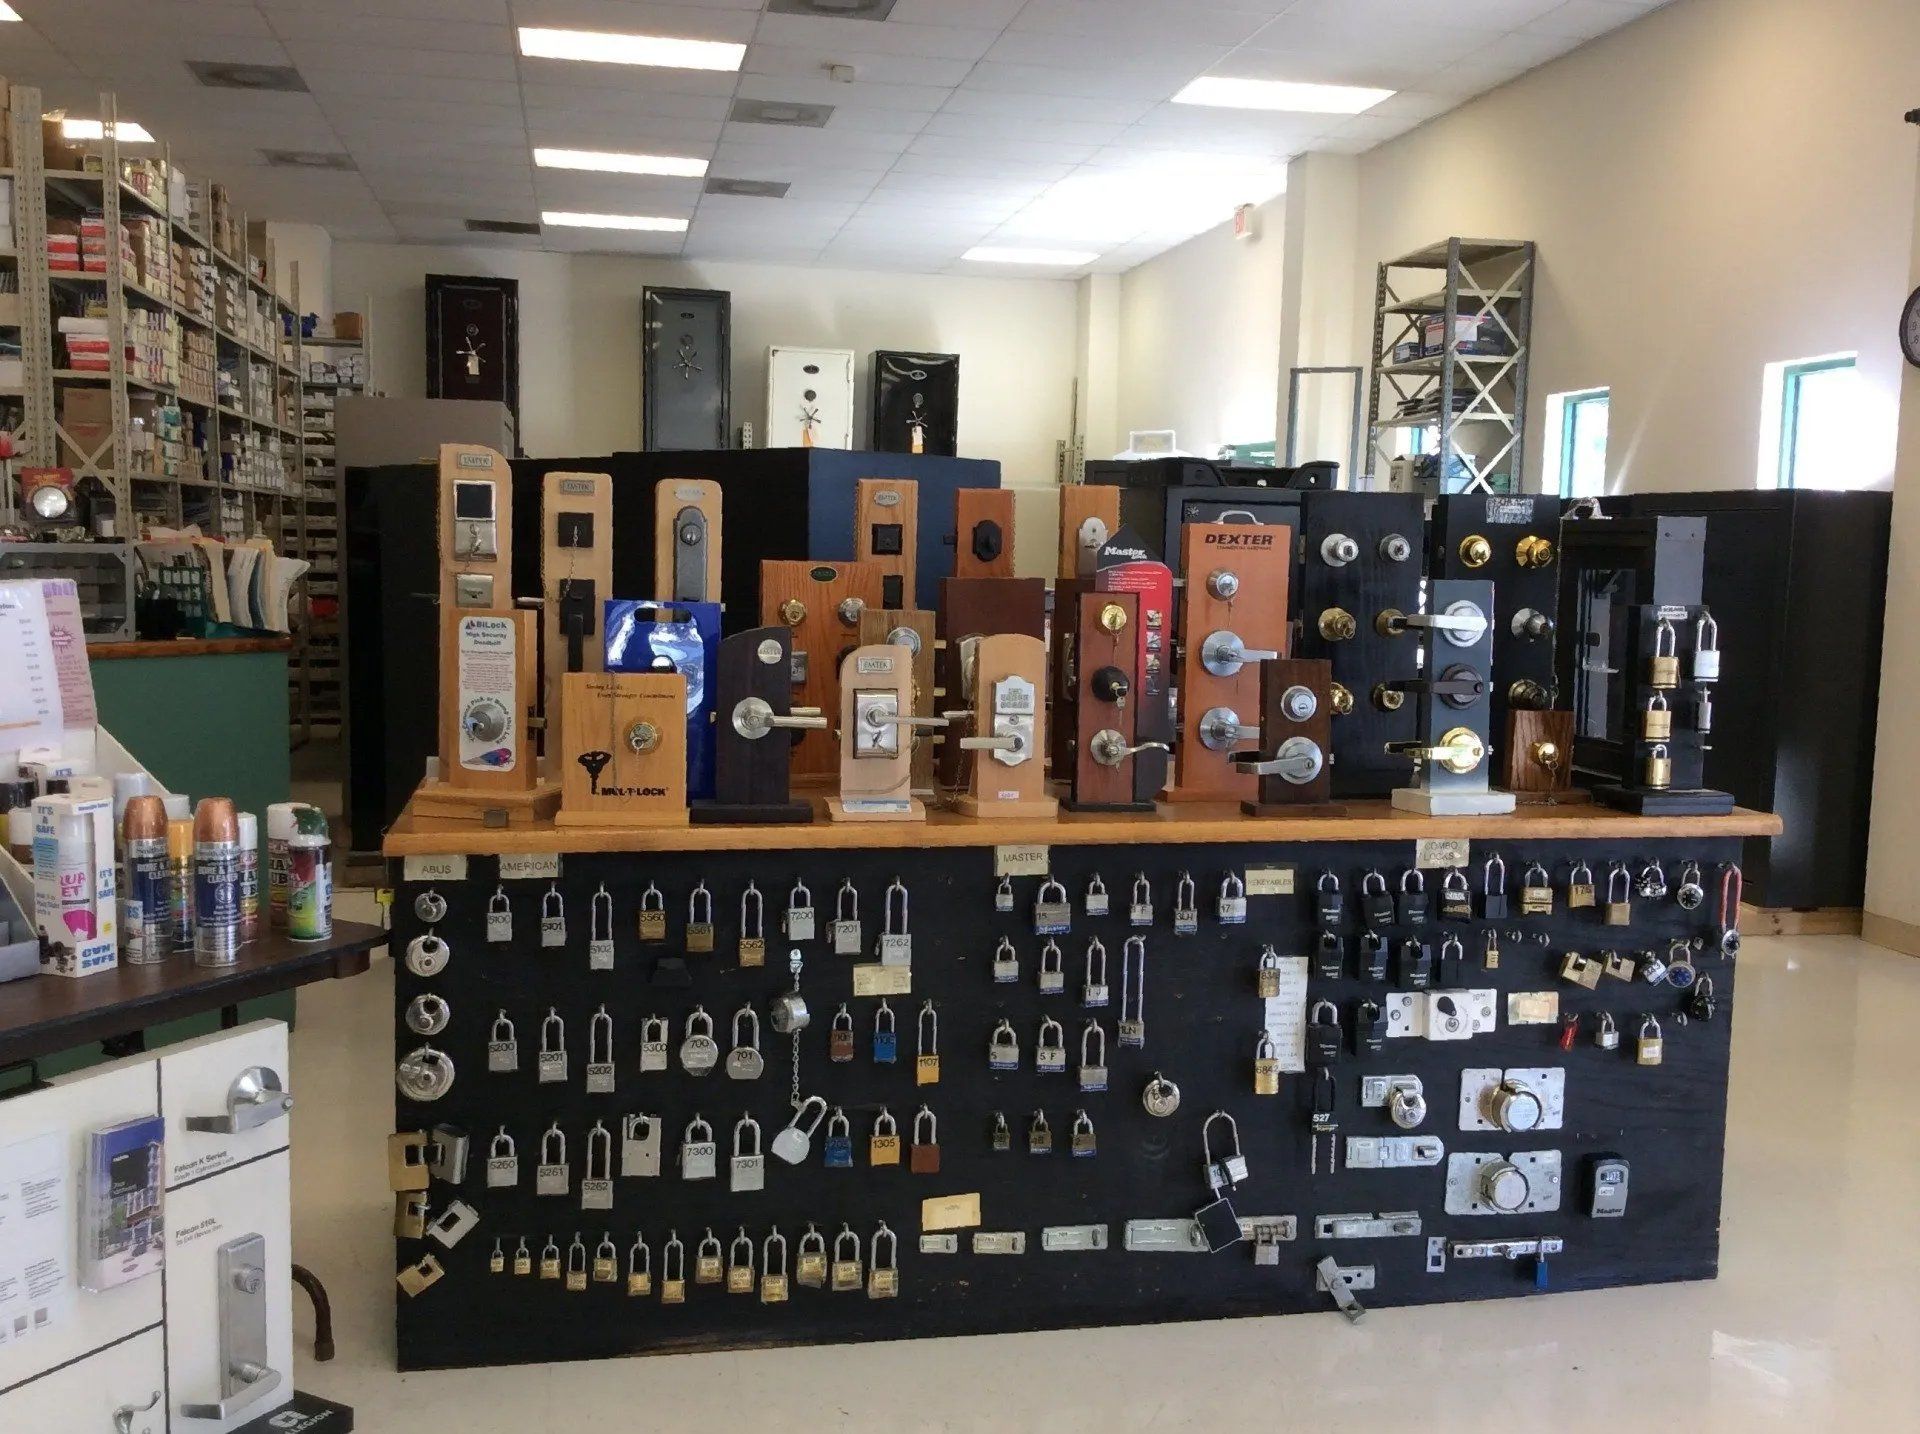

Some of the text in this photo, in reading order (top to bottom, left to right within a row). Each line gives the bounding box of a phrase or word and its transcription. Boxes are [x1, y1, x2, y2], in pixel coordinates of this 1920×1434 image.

[1204, 534, 1273, 546] DEXTER
[1104, 546, 1146, 557] Master
[1003, 852, 1043, 862] MASTER
[422, 864, 452, 874] ABUS
[500, 861, 557, 872] AMERICAN
[488, 915, 511, 925] 5100
[640, 913, 665, 922] 5560
[542, 922, 563, 931] 5101
[837, 925, 858, 934] 7201
[740, 940, 764, 950] 5562
[885, 938, 910, 947] 7262
[489, 1042, 514, 1052] 5200
[643, 1043, 668, 1052] 5300
[690, 1039, 709, 1048] 700
[539, 1053, 563, 1062] 5201
[736, 1051, 753, 1060] 701
[587, 1065, 612, 1075] 5202
[1312, 1113, 1331, 1122] 527
[873, 1138, 896, 1149] 1305
[687, 1147, 713, 1156] 7300
[174, 1161, 198, 1173] Falcon
[205, 1150, 228, 1163] Series
[489, 1160, 515, 1169] 5260
[736, 1159, 759, 1169] 7301
[539, 1167, 564, 1177] 5261
[583, 1181, 609, 1191] 5262
[175, 1225, 199, 1238] Falcon
